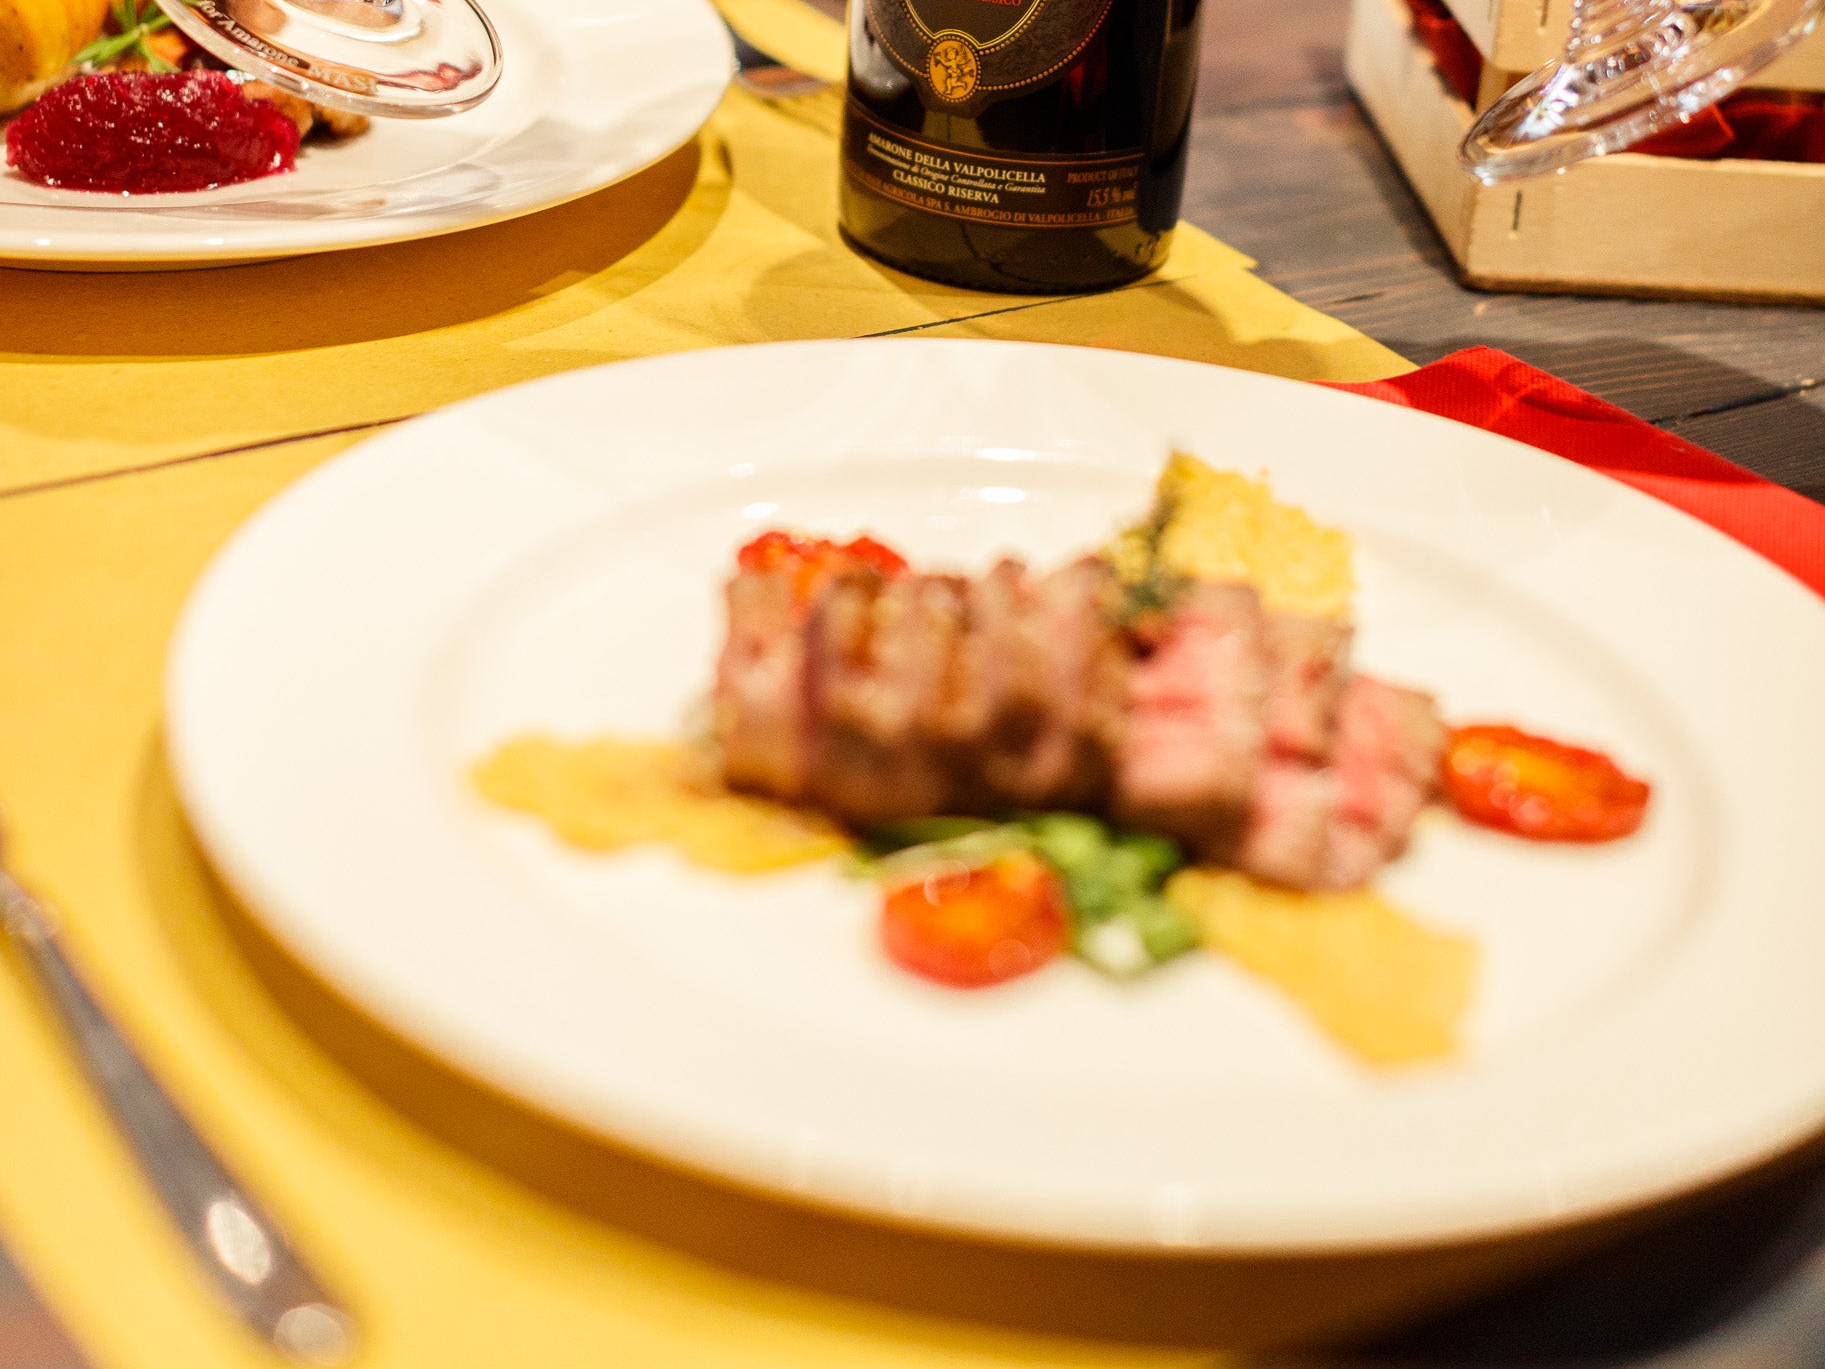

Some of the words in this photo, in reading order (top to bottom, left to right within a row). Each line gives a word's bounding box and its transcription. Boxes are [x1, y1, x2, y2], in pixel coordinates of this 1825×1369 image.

[914, 152, 950, 171] DELLA
[953, 162, 1046, 183] VALPOLICELLA
[893, 169, 945, 194] CLASSICO
[948, 185, 999, 204] RISERVA
